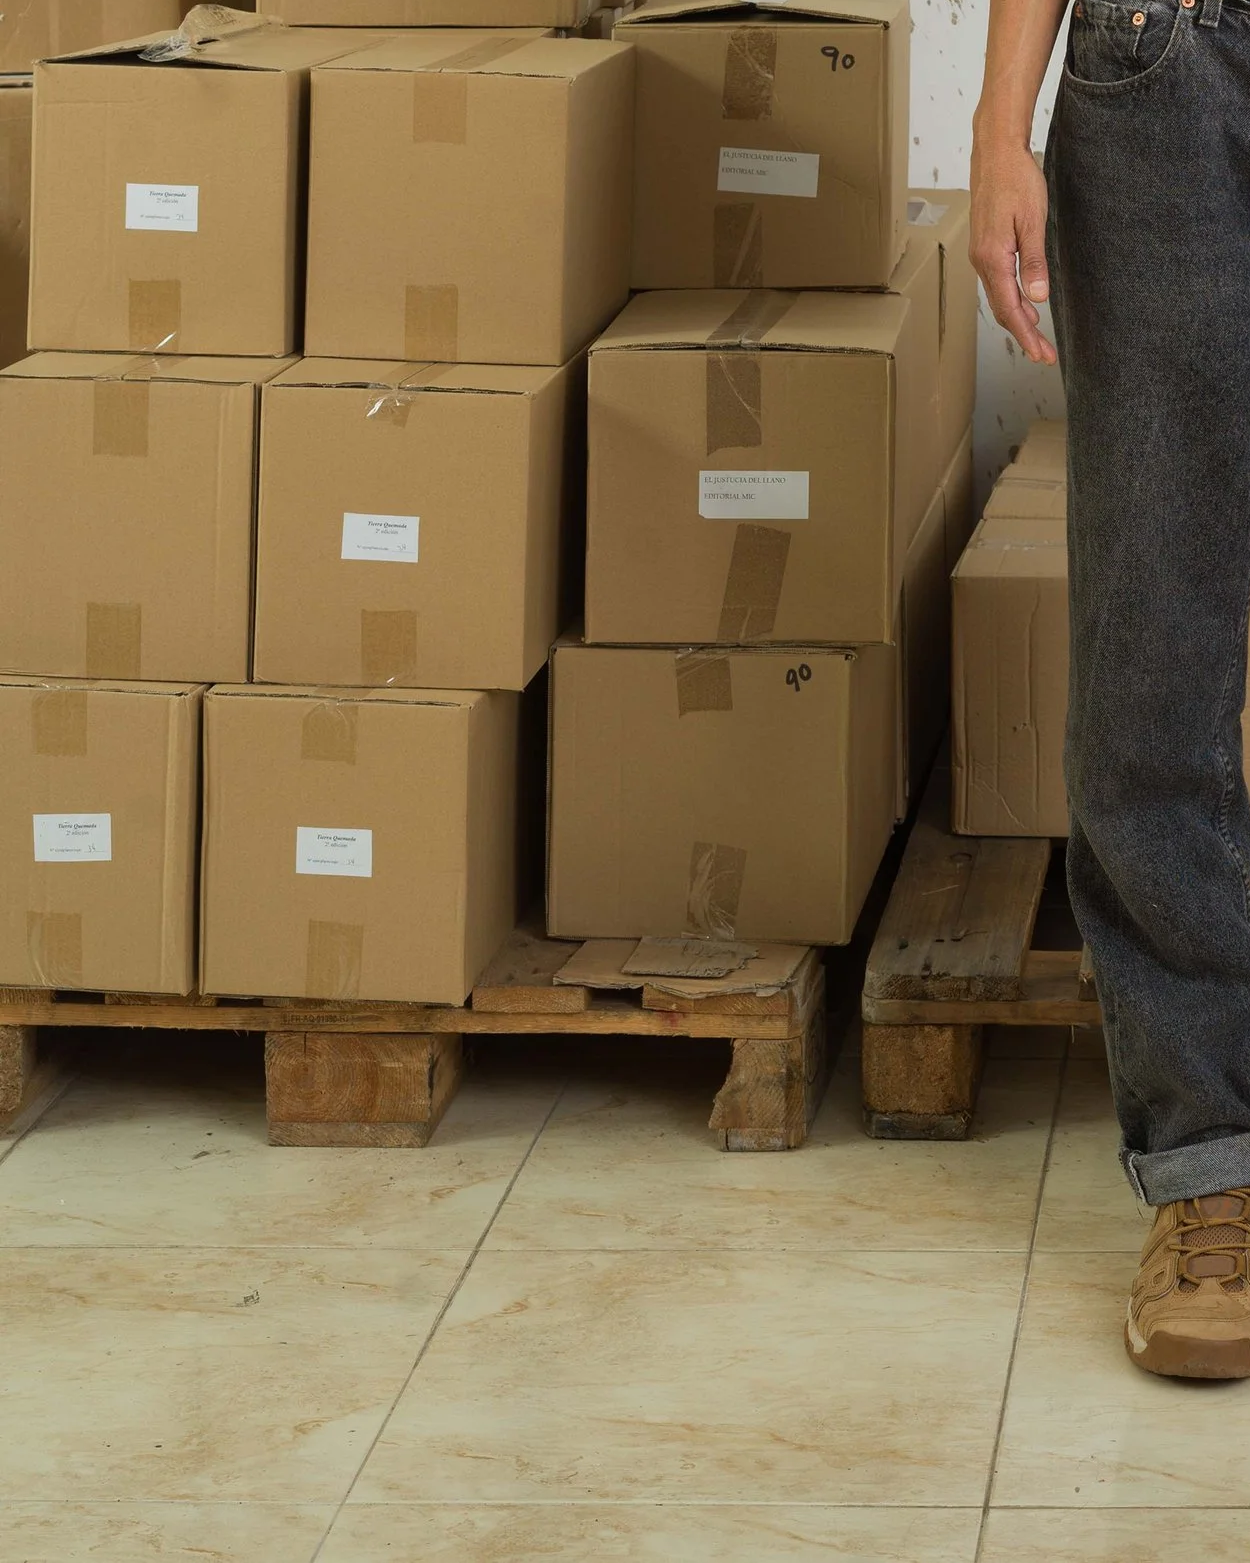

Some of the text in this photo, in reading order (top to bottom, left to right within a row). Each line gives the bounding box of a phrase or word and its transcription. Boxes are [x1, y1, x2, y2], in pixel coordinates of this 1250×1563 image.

[821, 45, 856, 72] 90
[704, 476, 713, 484] EL
[786, 663, 812, 692] 90
